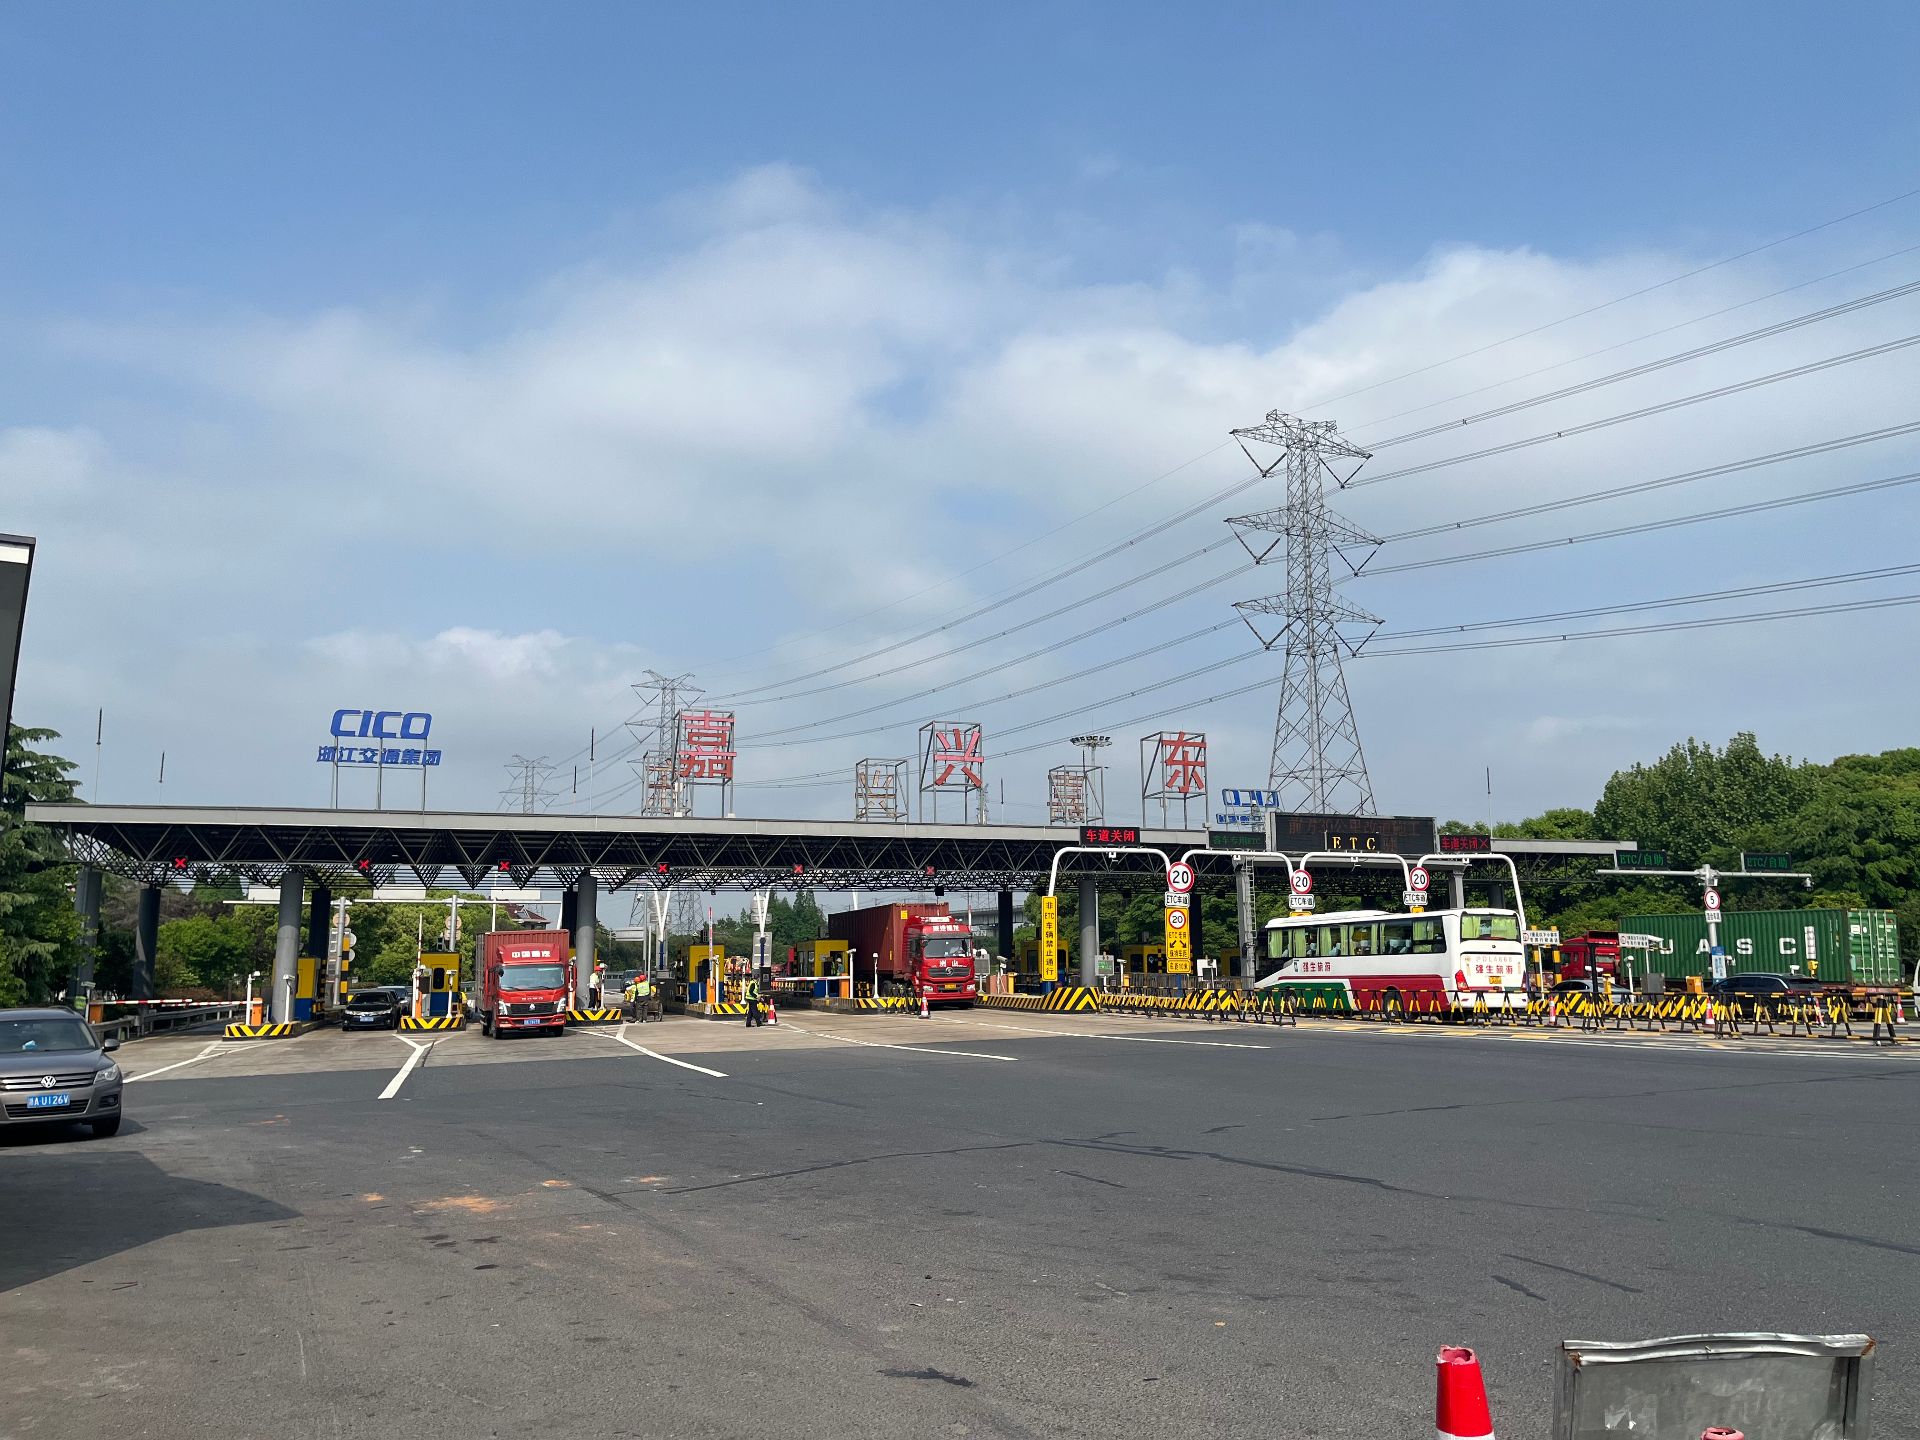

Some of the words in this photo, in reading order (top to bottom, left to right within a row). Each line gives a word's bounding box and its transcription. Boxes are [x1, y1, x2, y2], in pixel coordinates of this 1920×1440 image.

[330, 709, 432, 739] CICO
[316, 745, 441, 766] 浙江交通集团
[678, 710, 737, 778] 嘉
[934, 728, 984, 787] 兴
[1161, 731, 1207, 793] 东
[1086, 828, 1135, 843] 车道关闭
[1332, 836, 1376, 850] ETC
[1441, 836, 1479, 850] 车道关闭
[1619, 854, 1664, 867] ETC/自助
[1172, 870, 1189, 884] 20
[1295, 876, 1308, 888] 20
[1413, 873, 1426, 885] 20
[1166, 895, 1188, 905] ETC车道
[1290, 897, 1313, 906] ETC车道
[1404, 894, 1426, 903] ETC车道
[1710, 895, 1715, 905] 5
[1172, 915, 1183, 924] 20
[1475, 964, 1513, 975] 强生旅游
